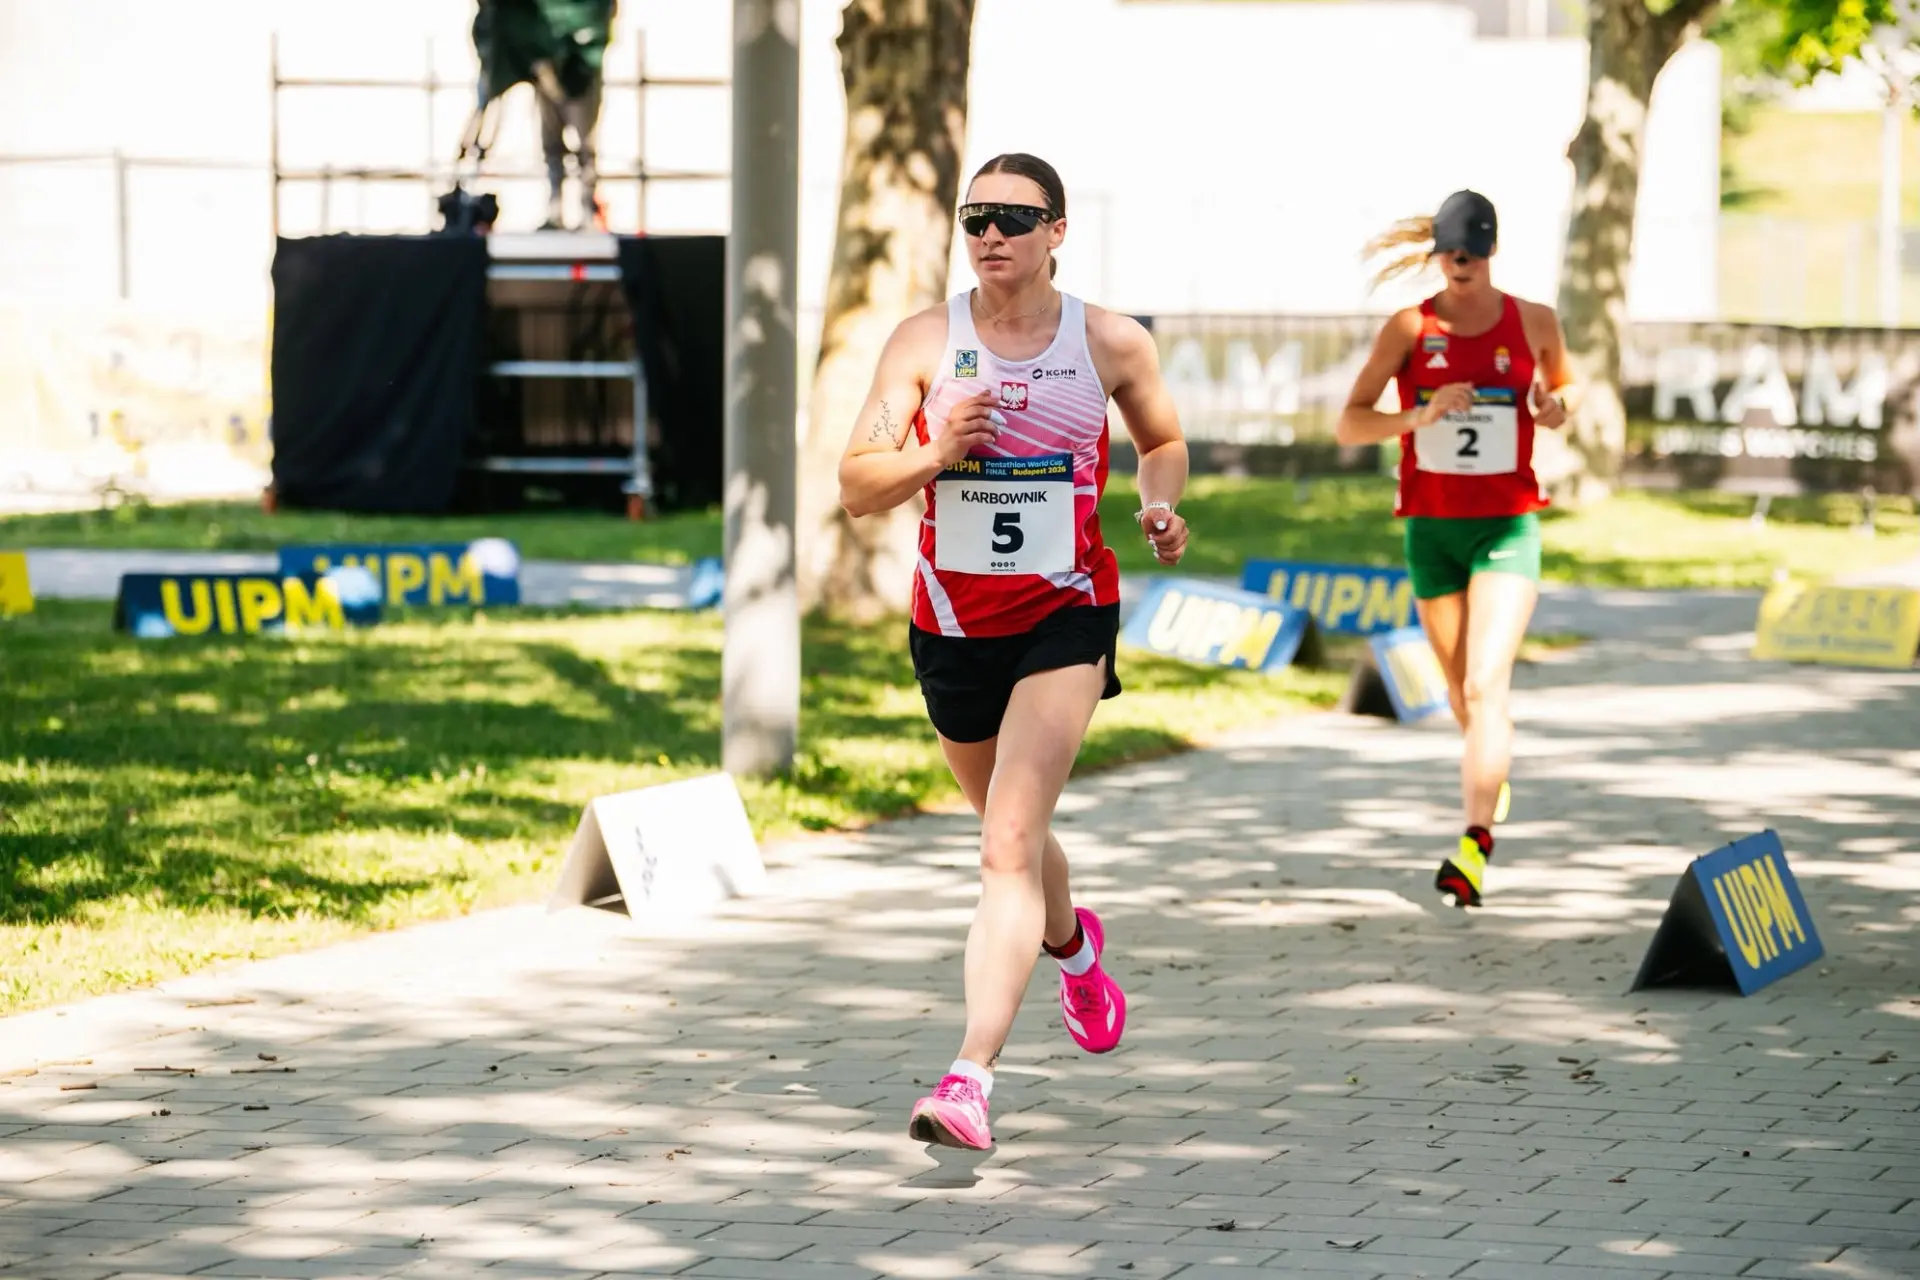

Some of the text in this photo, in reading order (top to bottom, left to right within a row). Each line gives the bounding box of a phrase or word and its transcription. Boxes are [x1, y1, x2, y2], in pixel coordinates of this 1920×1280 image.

[1046, 369, 1076, 377] KGHM
[1160, 339, 1303, 414] AM
[1653, 344, 1887, 429] RAM
[985, 459, 1063, 468] Pentathlon World Cup
[1456, 428, 1479, 457] 2
[1012, 467, 1047, 476] Budapest
[961, 490, 1048, 505] KARBOWNIK
[992, 512, 1024, 554] 5
[160, 577, 345, 635] UIPM
[1148, 588, 1283, 669] UIPM
[1713, 854, 1807, 969] UIPM
